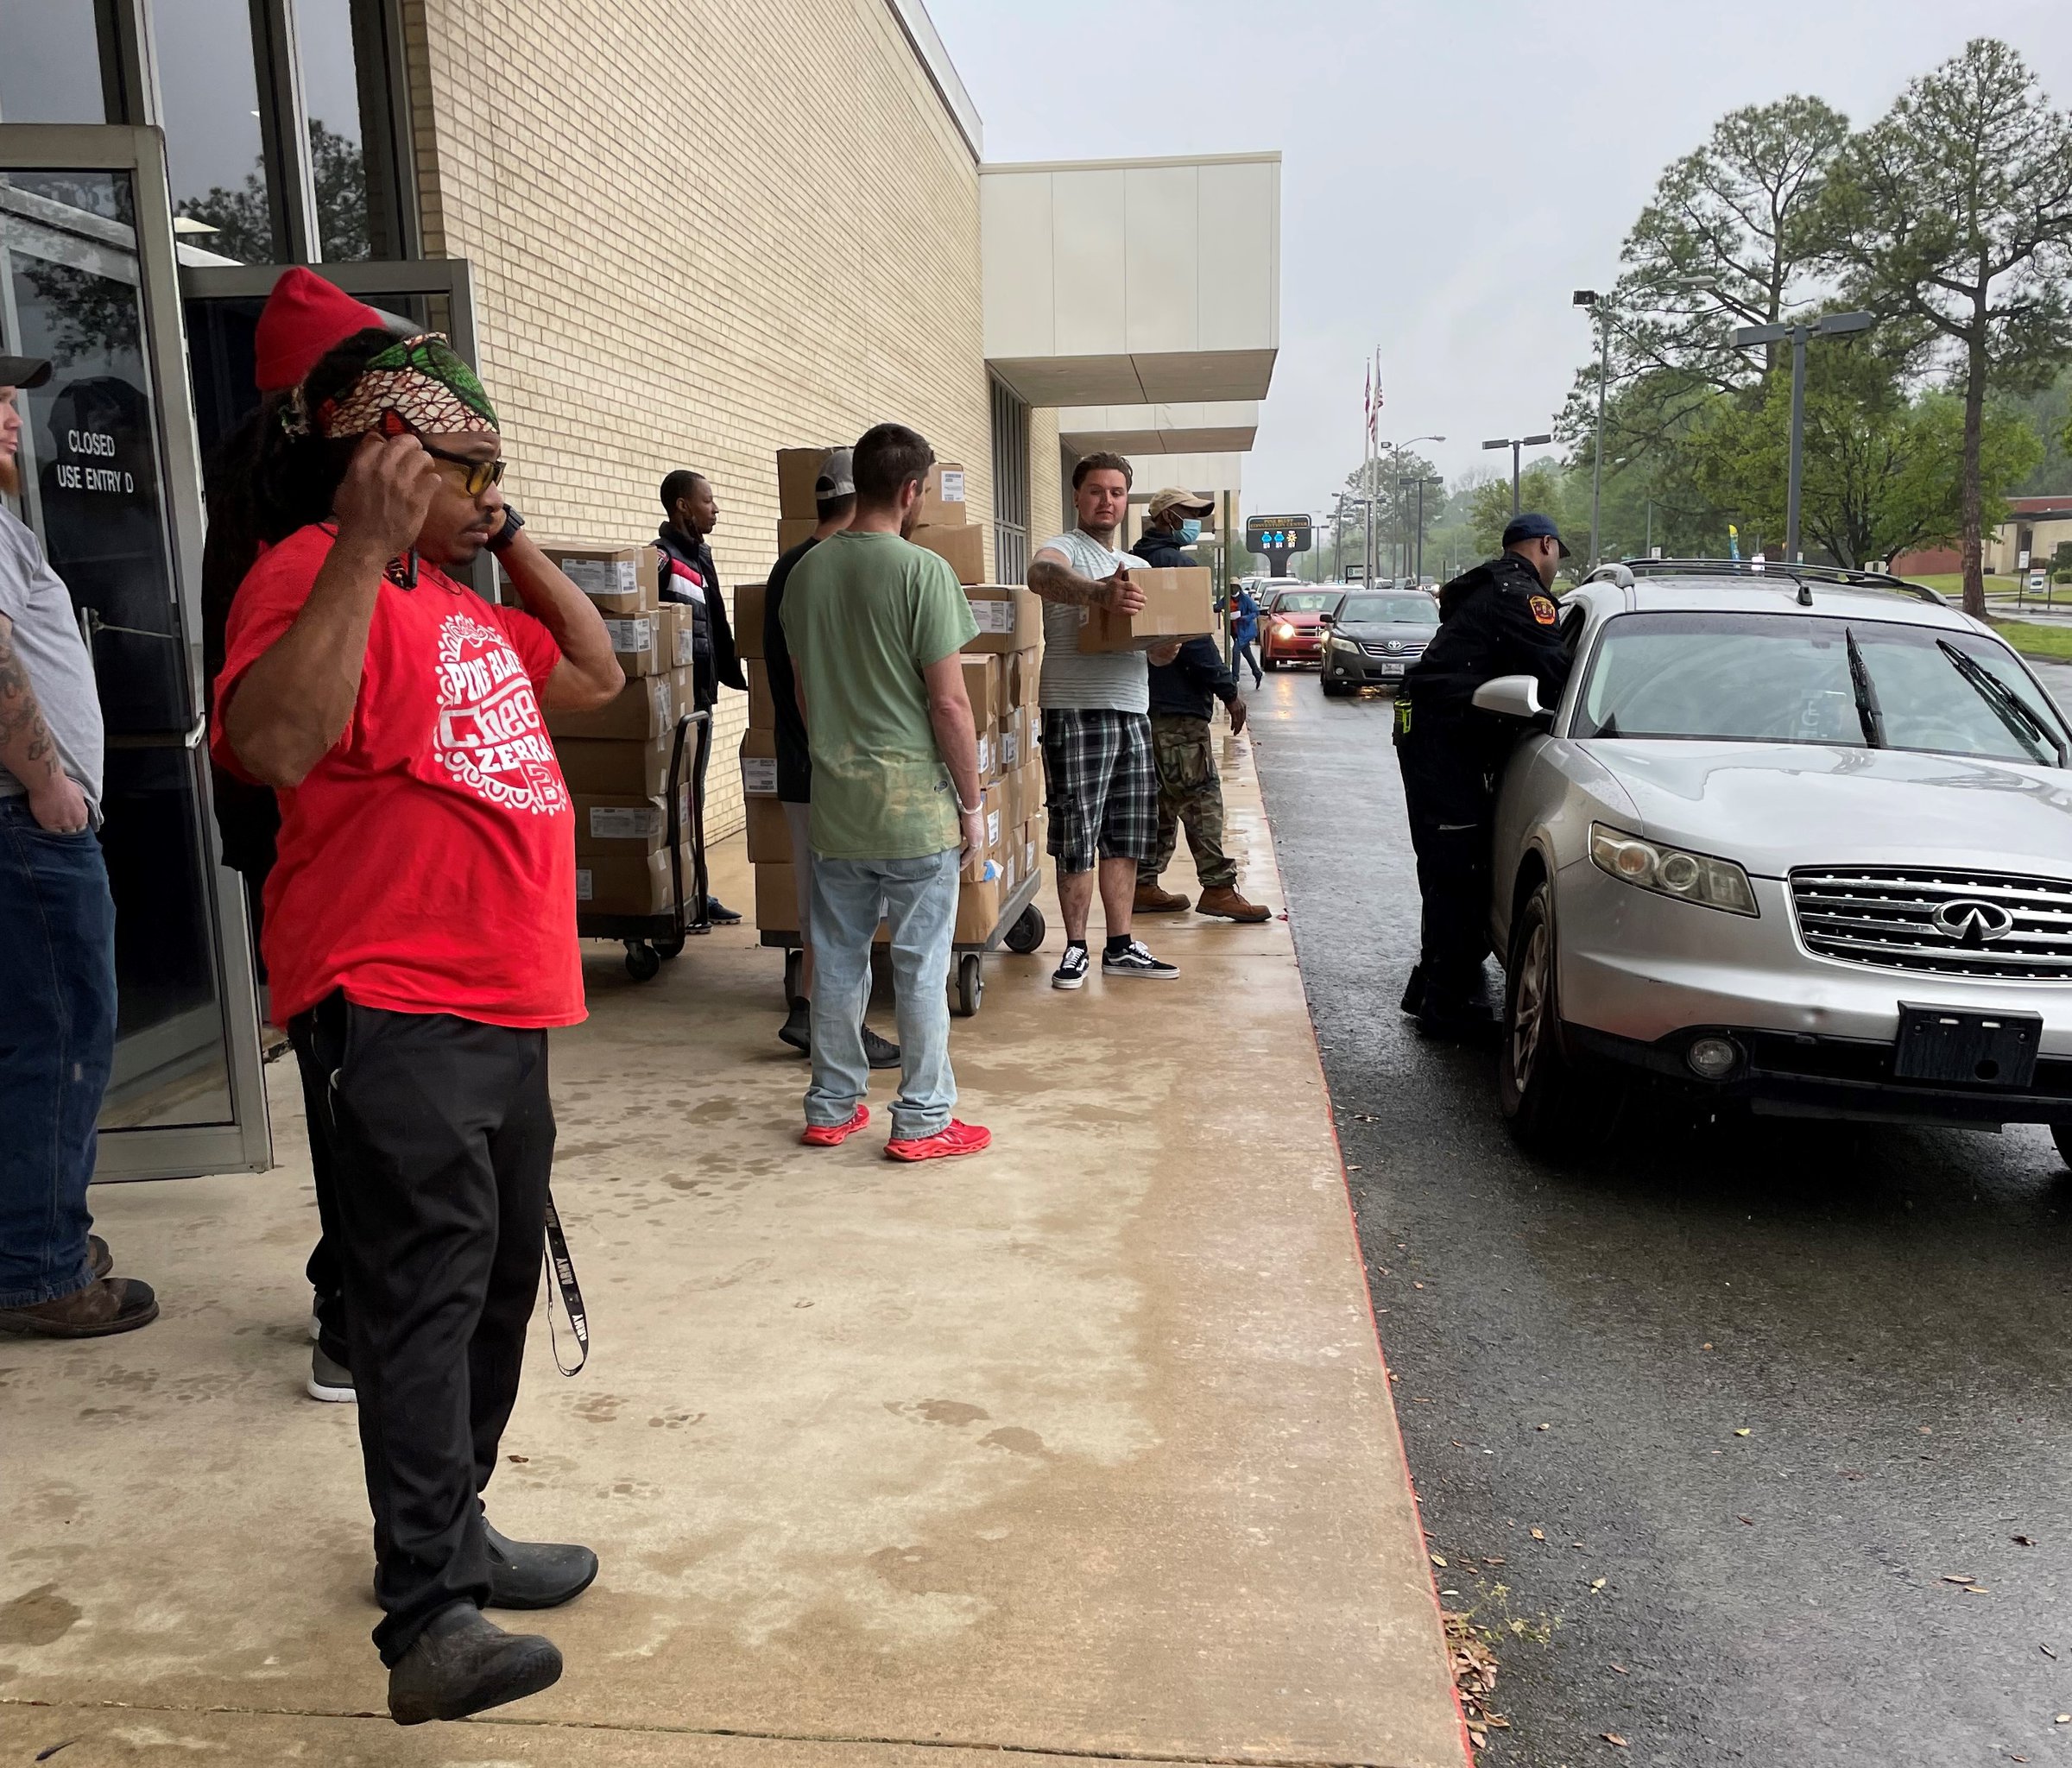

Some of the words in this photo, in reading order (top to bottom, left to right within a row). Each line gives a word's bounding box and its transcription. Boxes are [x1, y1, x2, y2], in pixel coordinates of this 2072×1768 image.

[68, 429, 115, 458] CLOSED
[57, 464, 82, 488] USE
[85, 467, 121, 492] ENTRY
[124, 472, 134, 493] D
[444, 660, 492, 705] PINE
[556, 1258, 574, 1285] ARMY
[572, 1313, 587, 1342] ARMY
